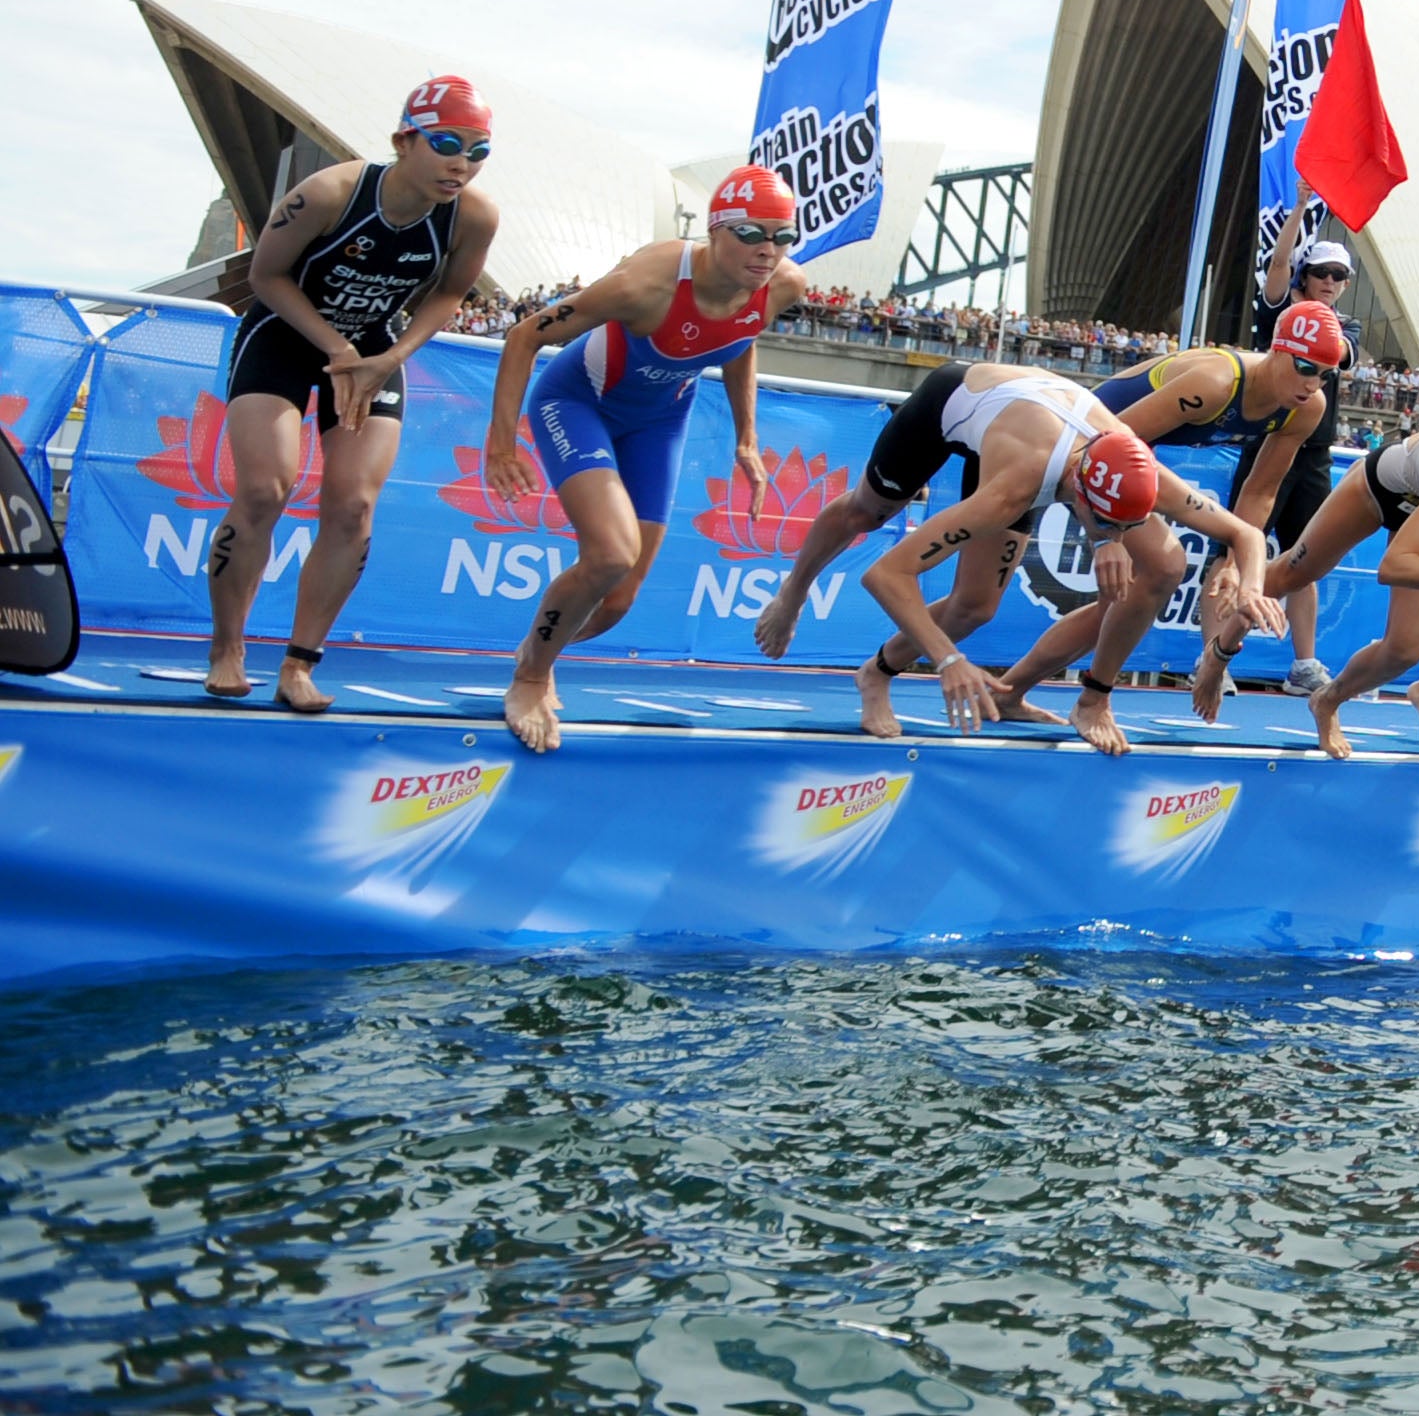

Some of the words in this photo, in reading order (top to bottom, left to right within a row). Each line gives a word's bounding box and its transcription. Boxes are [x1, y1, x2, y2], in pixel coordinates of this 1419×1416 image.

[411, 83, 449, 108] 27
[719, 180, 755, 203] 44
[332, 265, 420, 286] Shaklee
[323, 293, 394, 313] JPN
[1291, 315, 1321, 344] 02
[1089, 459, 1124, 500] 31
[370, 765, 481, 803] DEXTRO
[426, 781, 482, 812] ENERGY
[796, 776, 887, 812] DEXTRO
[842, 791, 888, 818] ENERGY
[1146, 786, 1221, 819] DEXTRO
[1184, 799, 1222, 825] ENERGY
